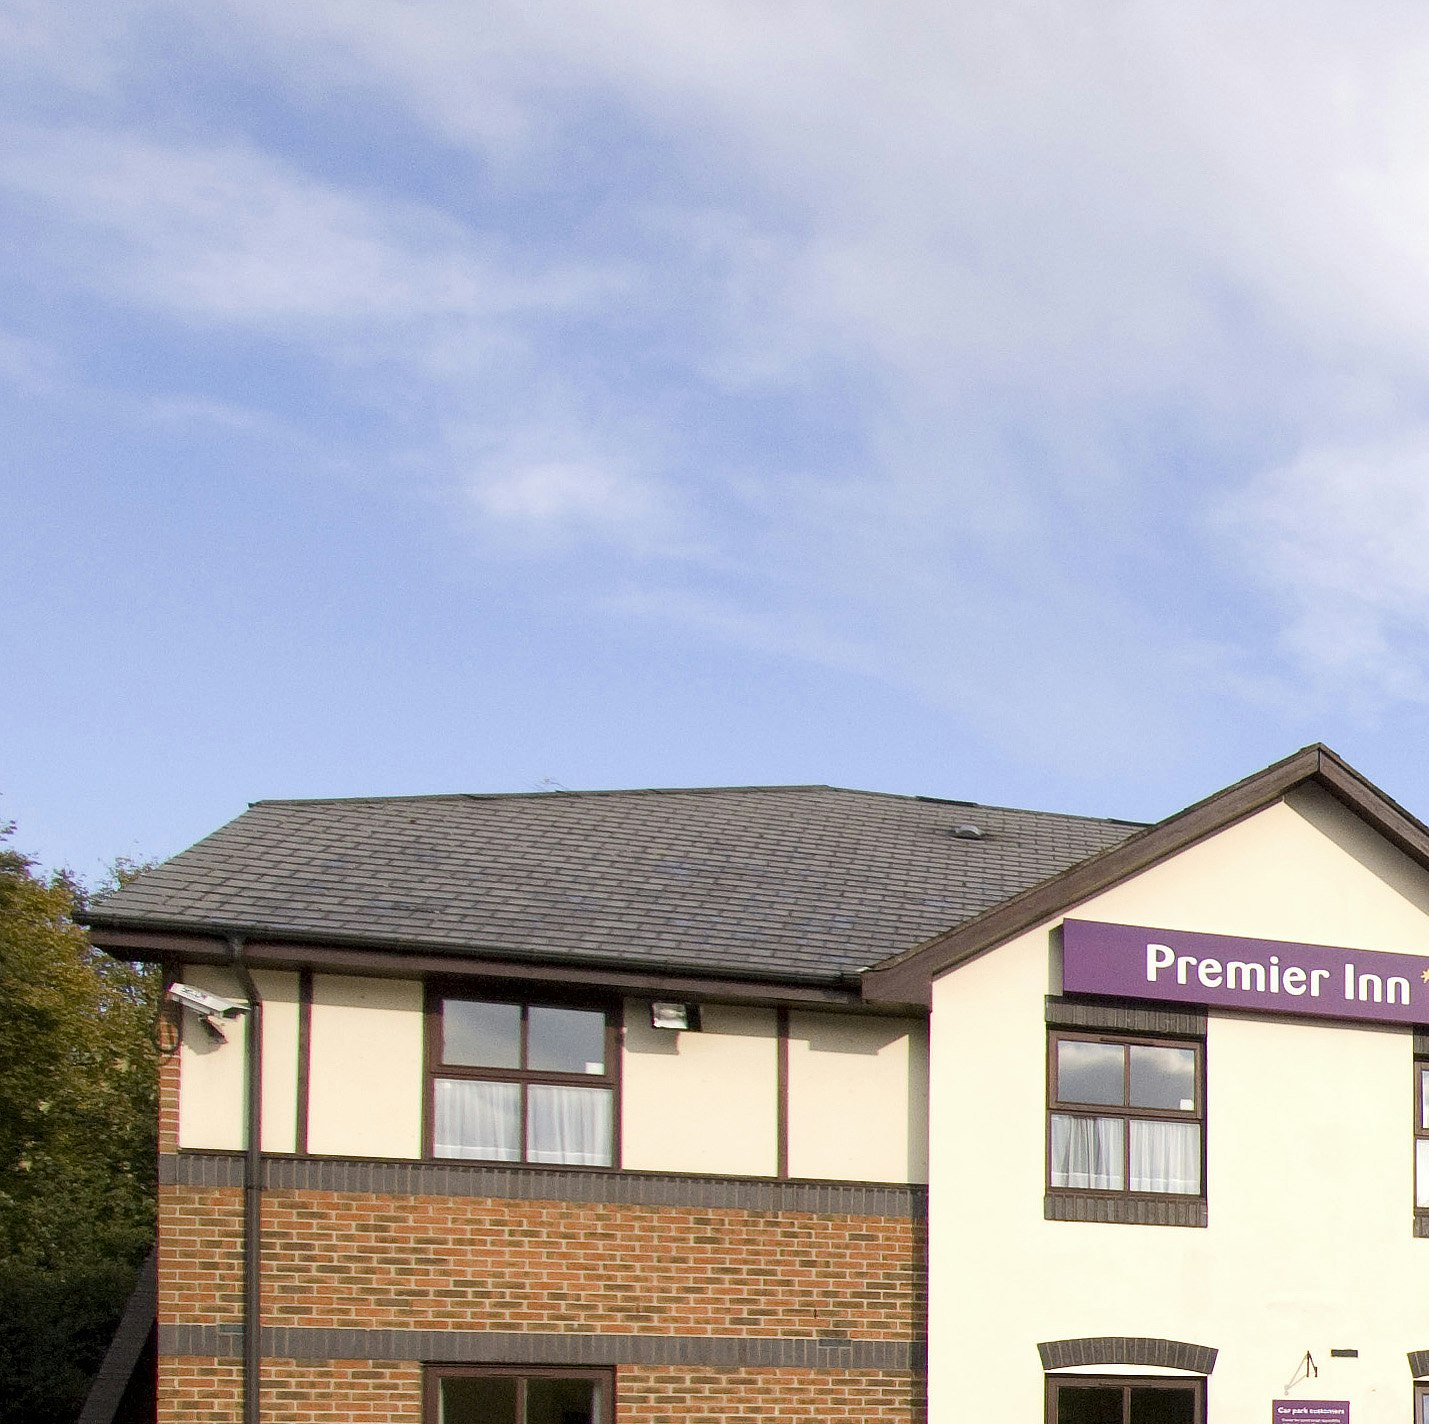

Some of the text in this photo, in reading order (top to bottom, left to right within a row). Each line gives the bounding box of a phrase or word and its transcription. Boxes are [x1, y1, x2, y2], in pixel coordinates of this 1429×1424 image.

[1146, 943, 1411, 1006] Premier Inn
[1292, 1407, 1309, 1415] park
